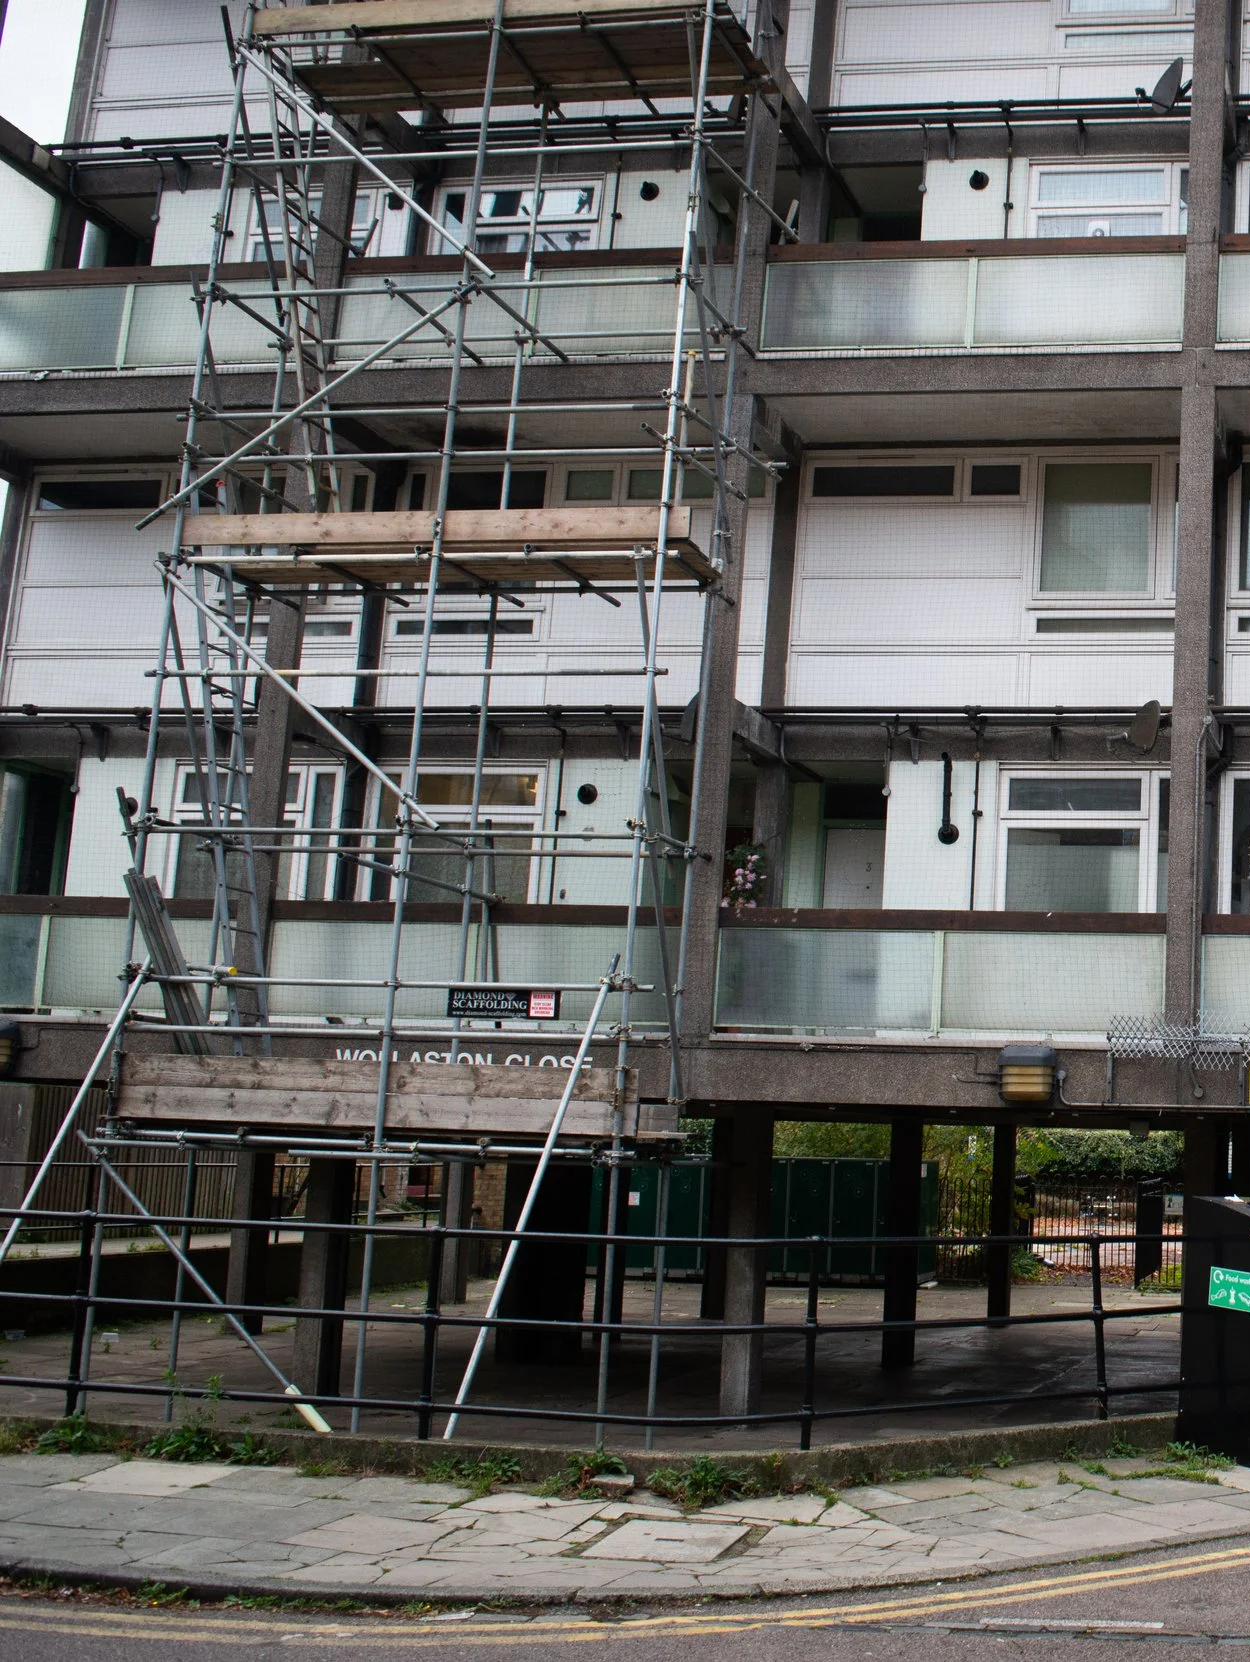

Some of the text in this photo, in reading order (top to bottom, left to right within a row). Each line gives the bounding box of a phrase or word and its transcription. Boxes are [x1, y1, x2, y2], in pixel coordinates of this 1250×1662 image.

[454, 991, 505, 1000] DIAMOND
[452, 999, 528, 1010] SCAFFOLDING
[1225, 1274, 1239, 1283] Food
